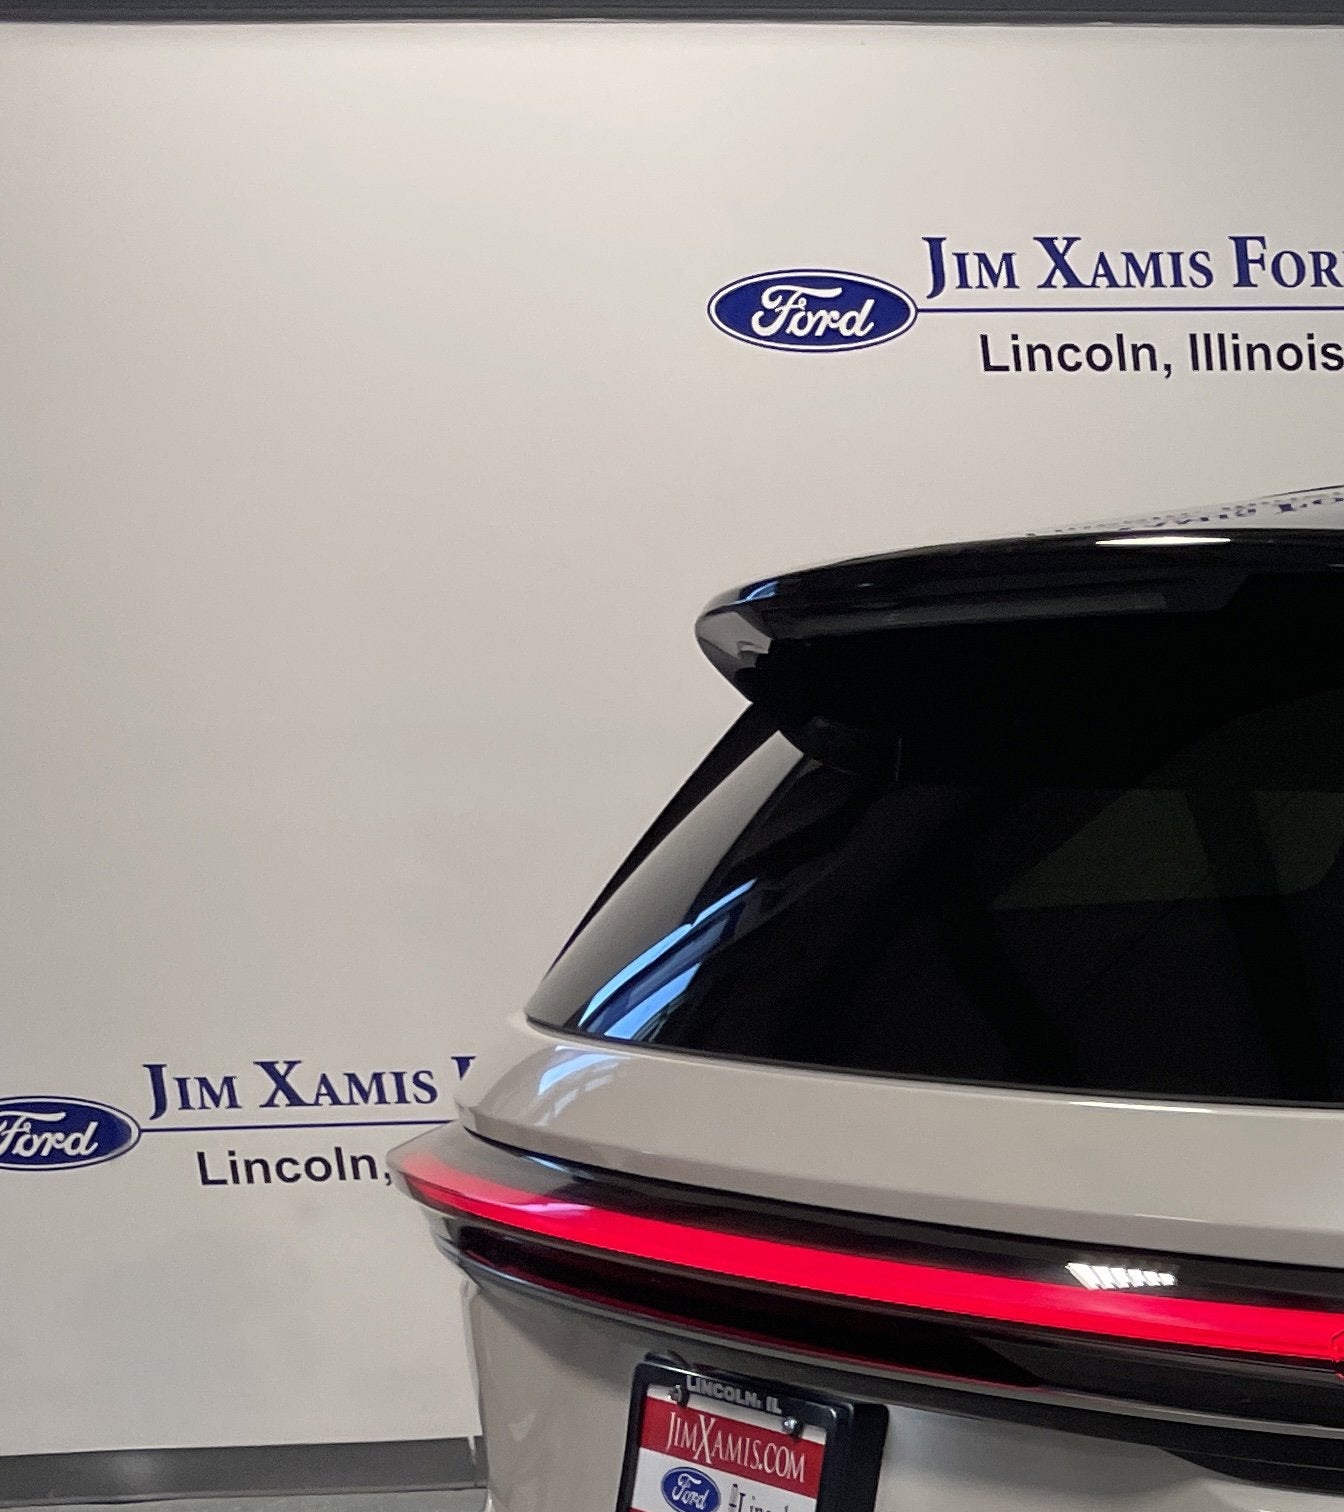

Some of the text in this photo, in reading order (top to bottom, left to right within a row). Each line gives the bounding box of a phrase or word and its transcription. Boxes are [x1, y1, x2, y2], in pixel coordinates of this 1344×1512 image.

[922, 236, 1017, 298] JIM
[1033, 236, 1213, 289] XAMIS
[751, 285, 874, 338] Ford
[980, 332, 1344, 378] Lincoln, Illinois
[143, 1064, 240, 1120] JIM
[253, 1060, 438, 1108] XAMIS
[197, 1147, 392, 1186] Lincoln,
[672, 1473, 709, 1510] Ford
